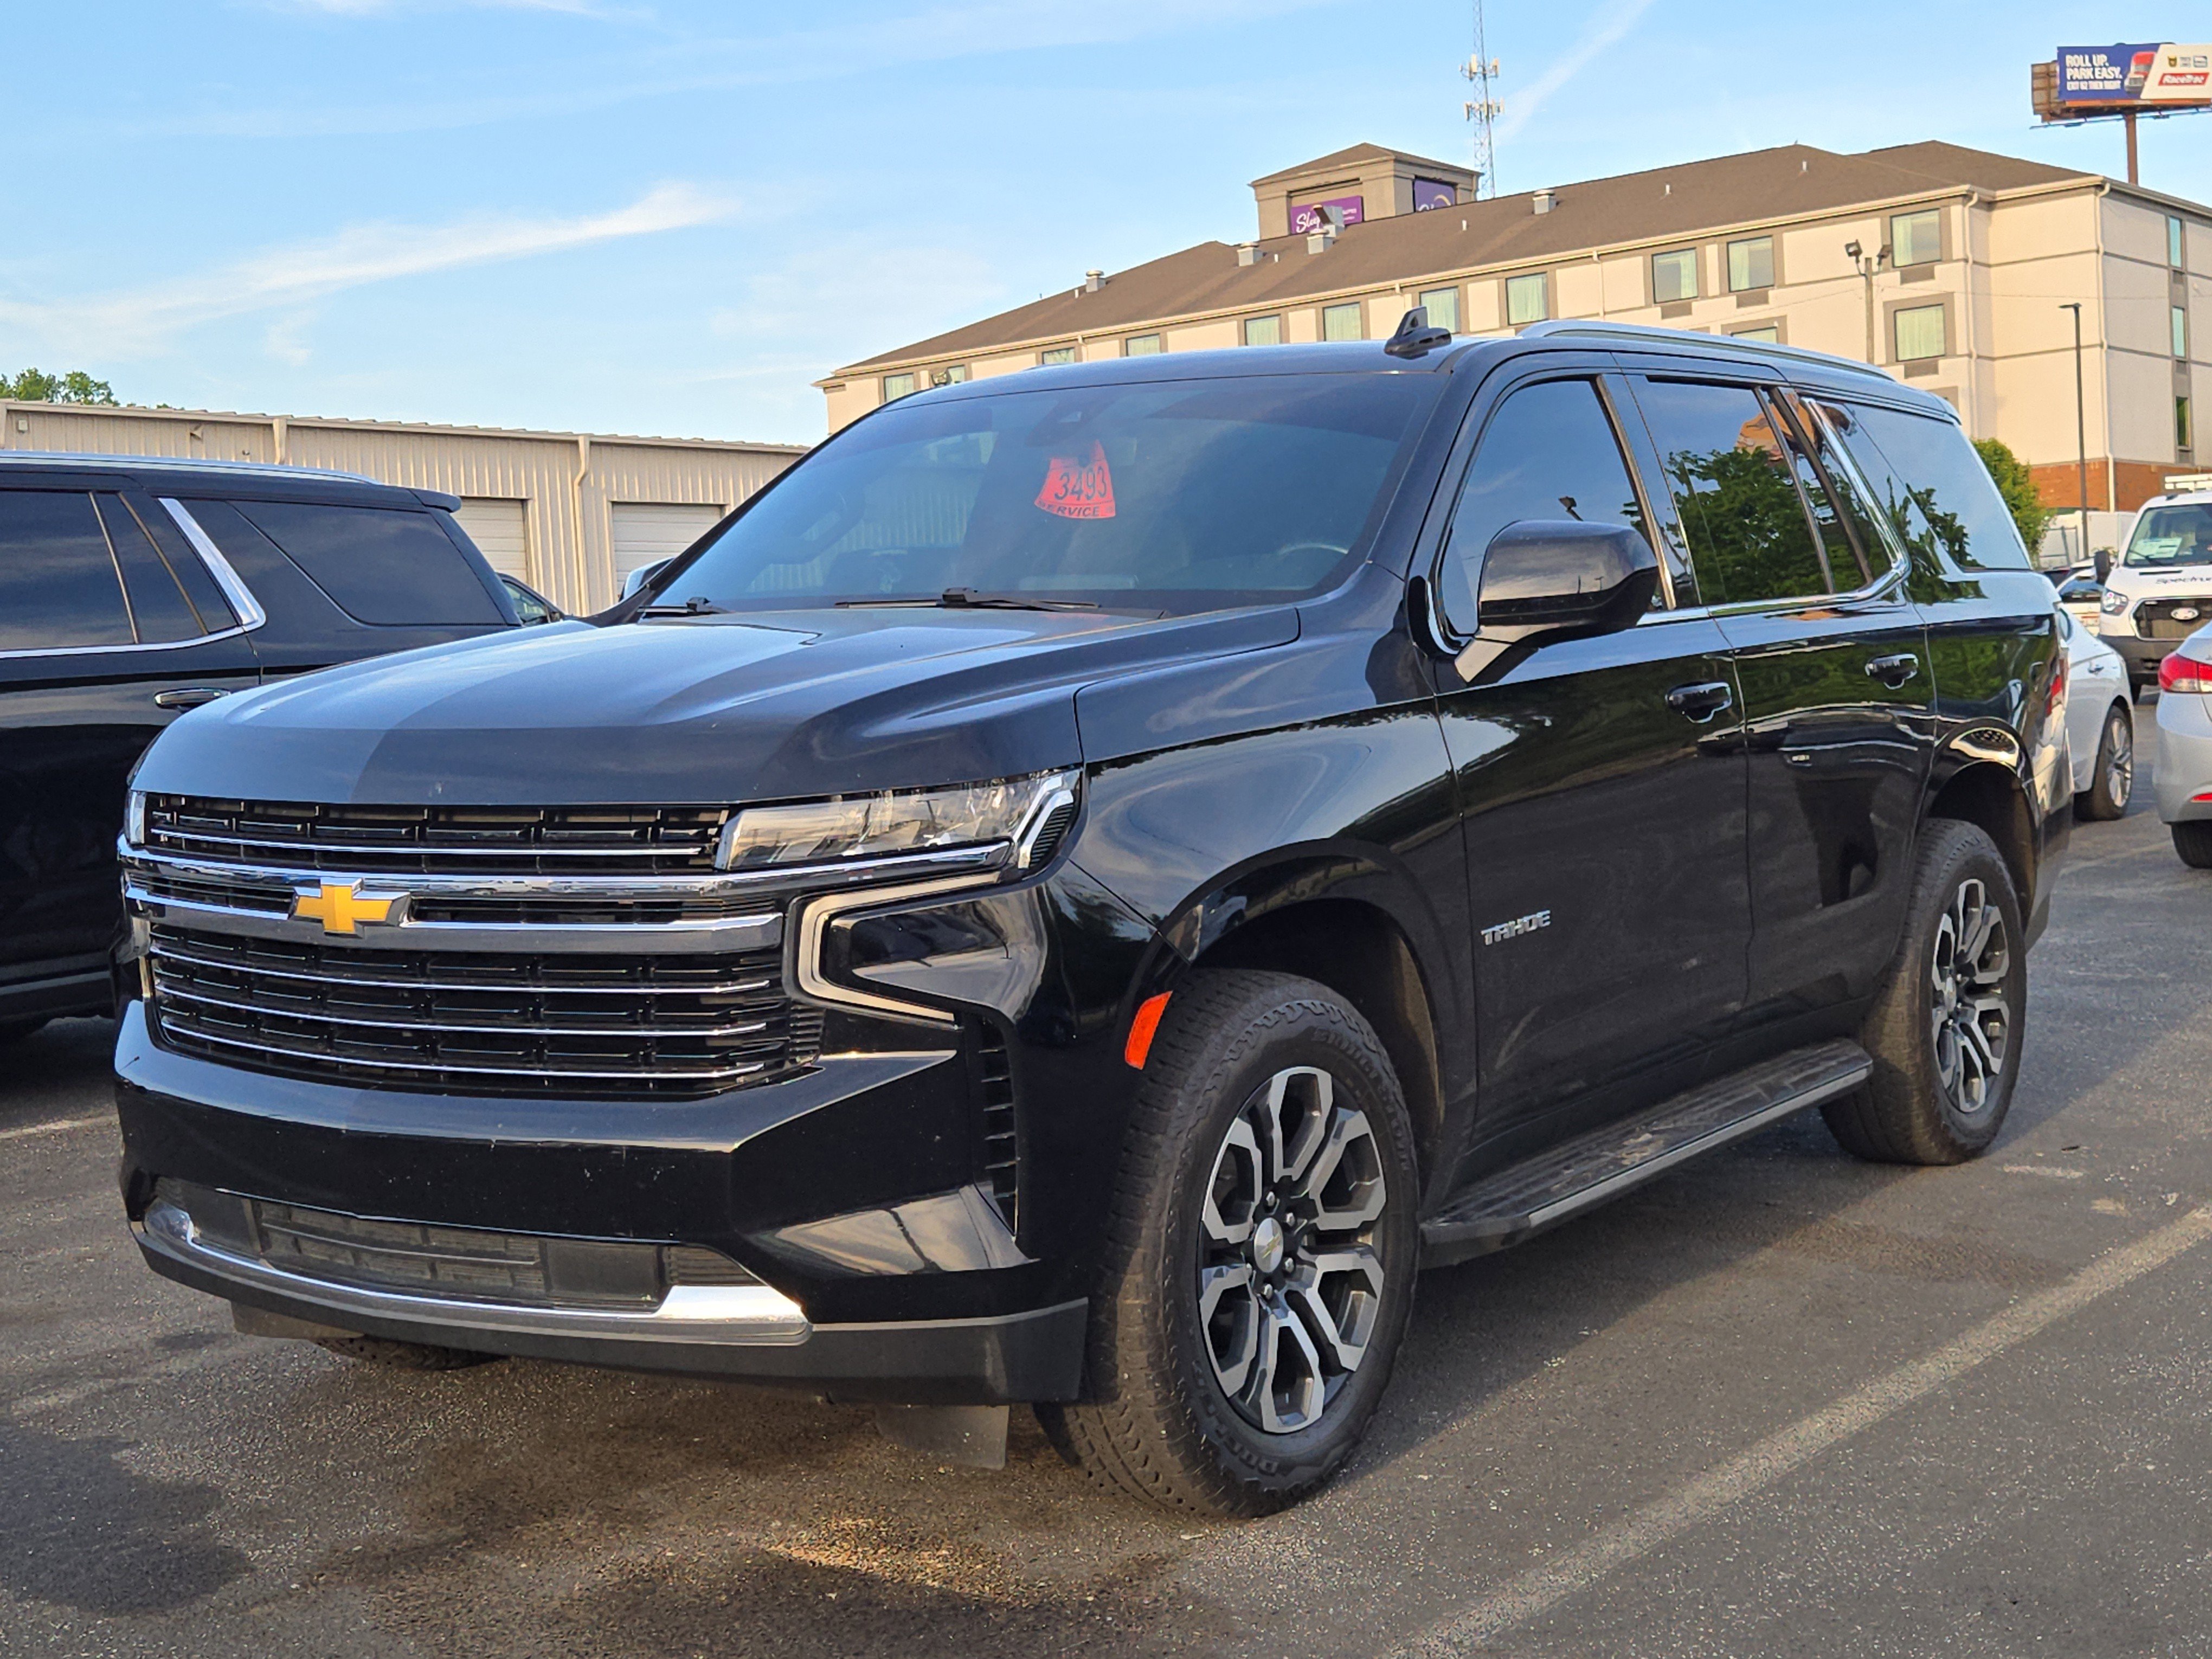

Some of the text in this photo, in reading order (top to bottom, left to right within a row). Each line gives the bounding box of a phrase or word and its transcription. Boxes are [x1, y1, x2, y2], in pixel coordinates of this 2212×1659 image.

[2066, 54, 2109, 67] ROLL UP.
[2066, 66, 2123, 80] PARK EASY.
[1054, 466, 1107, 500] 3493
[1038, 501, 1100, 517] SERVICE
[1480, 910, 1551, 946] TAHOE
